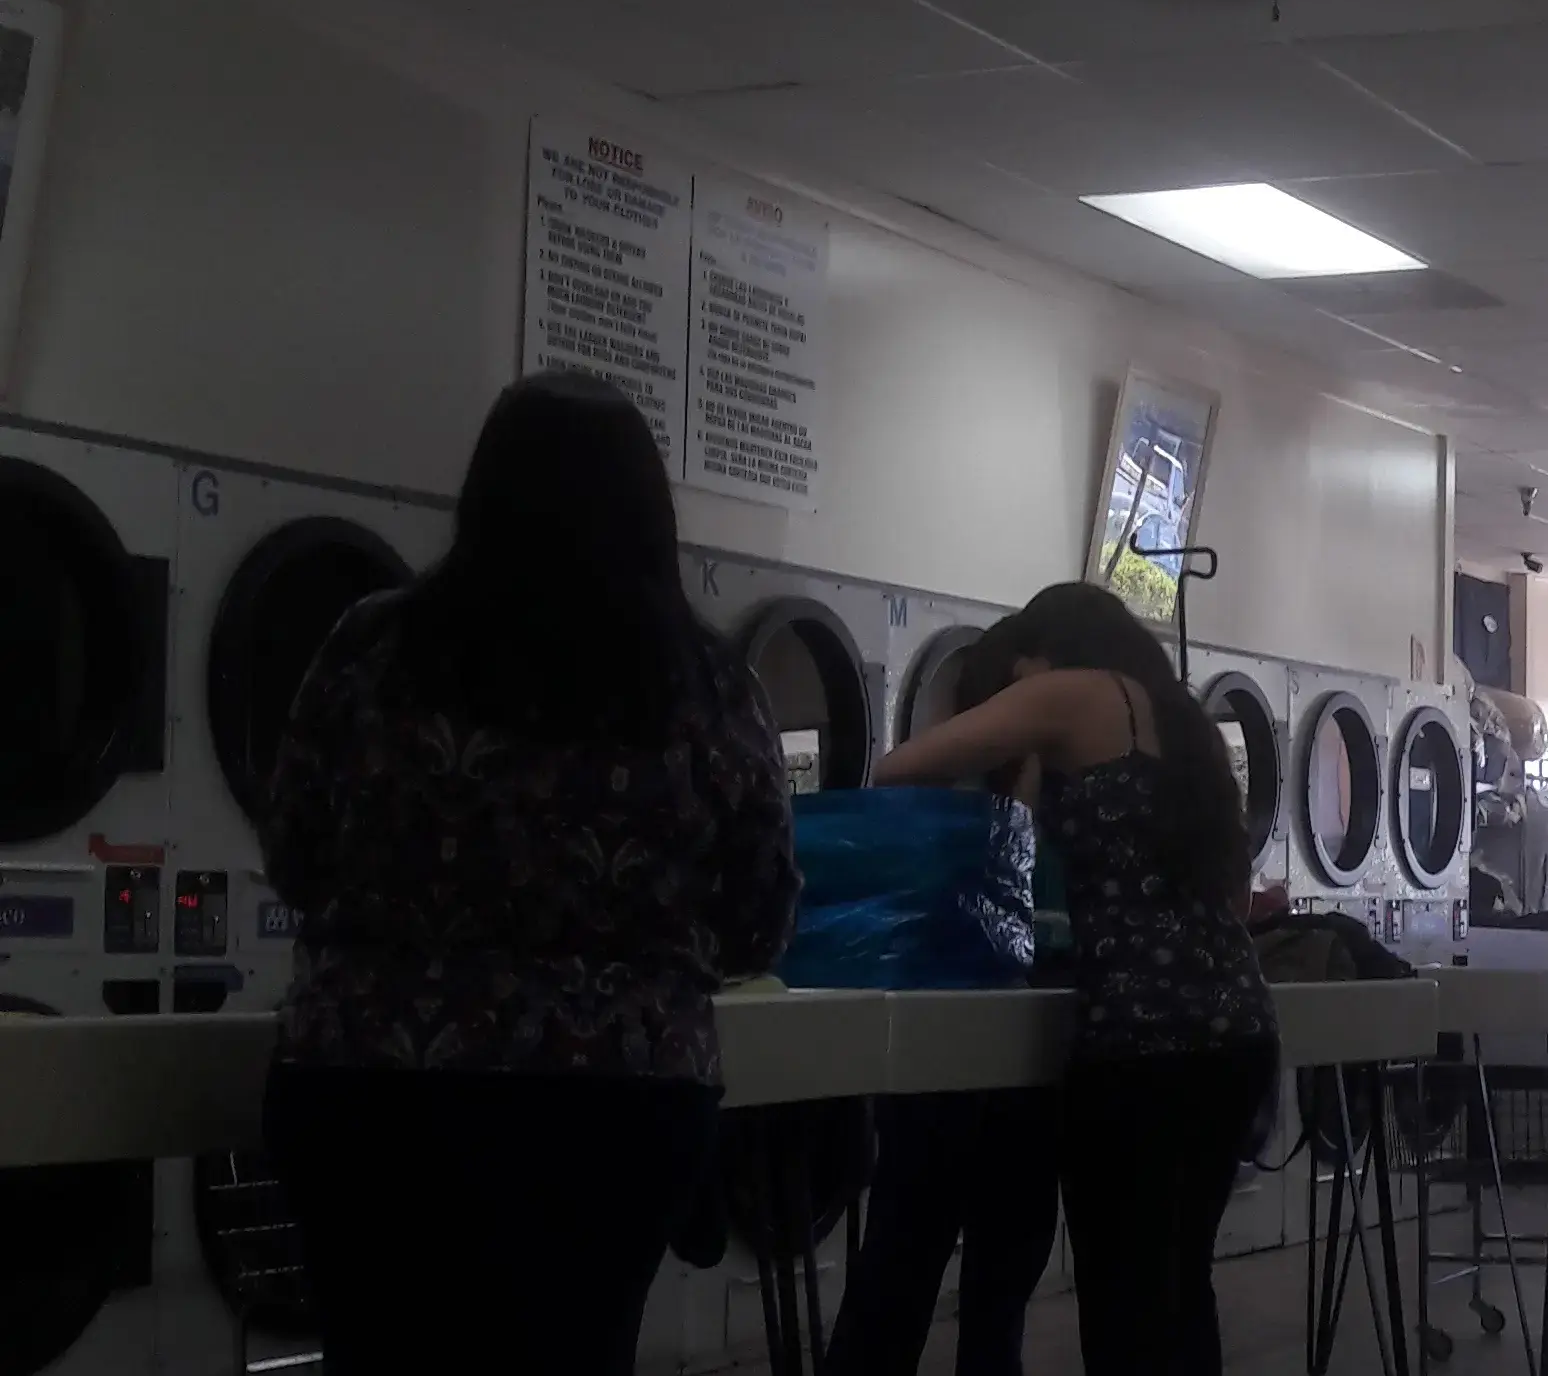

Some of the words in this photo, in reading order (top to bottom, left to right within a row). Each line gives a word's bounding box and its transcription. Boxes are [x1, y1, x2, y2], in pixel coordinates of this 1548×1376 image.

[587, 135, 644, 172] NOTICE
[192, 470, 220, 517] G
[702, 558, 720, 596] K
[890, 596, 908, 628] M
